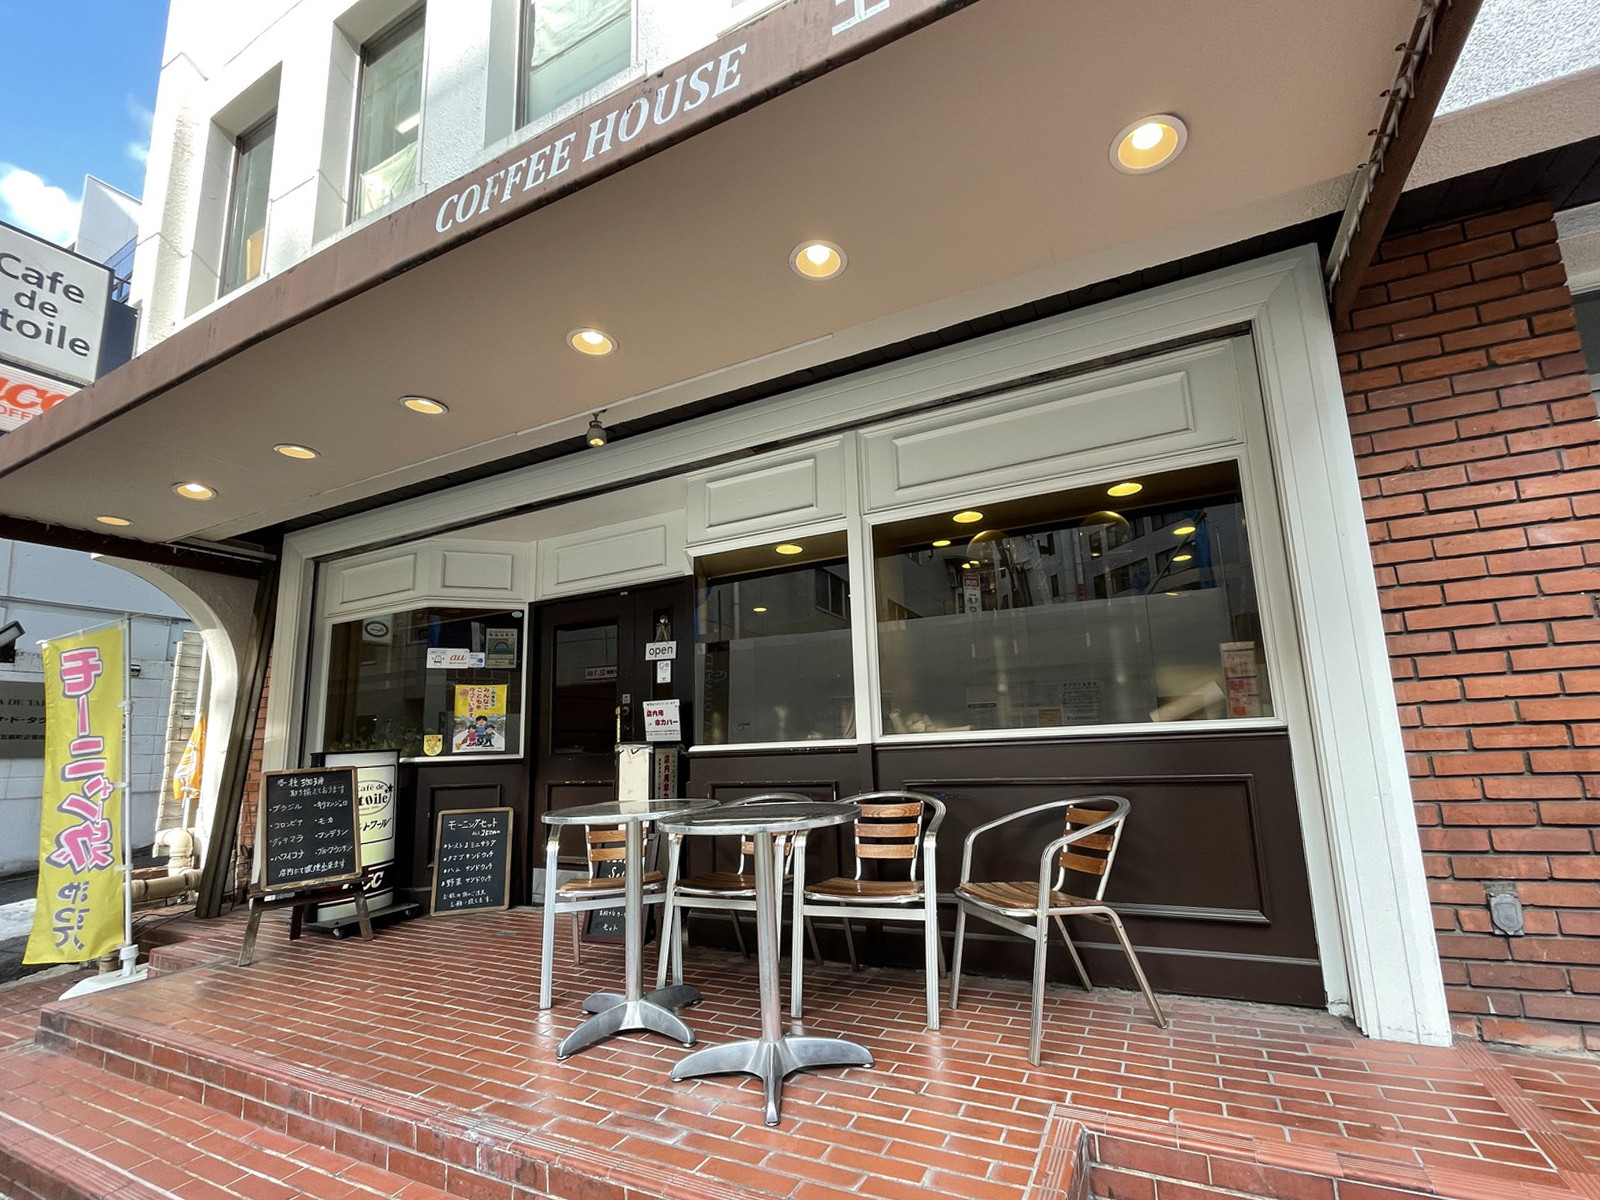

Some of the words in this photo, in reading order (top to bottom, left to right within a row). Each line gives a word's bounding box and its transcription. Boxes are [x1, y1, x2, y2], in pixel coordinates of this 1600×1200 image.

[434, 131, 577, 234] COFFEE
[582, 43, 748, 164] HOUSE
[0, 252, 85, 304] Cafe
[14, 290, 58, 318] de
[450, 653, 467, 661] au
[649, 645, 673, 659] open
[360, 817, 393, 831] トワール
[448, 817, 498, 830] モーニングセット
